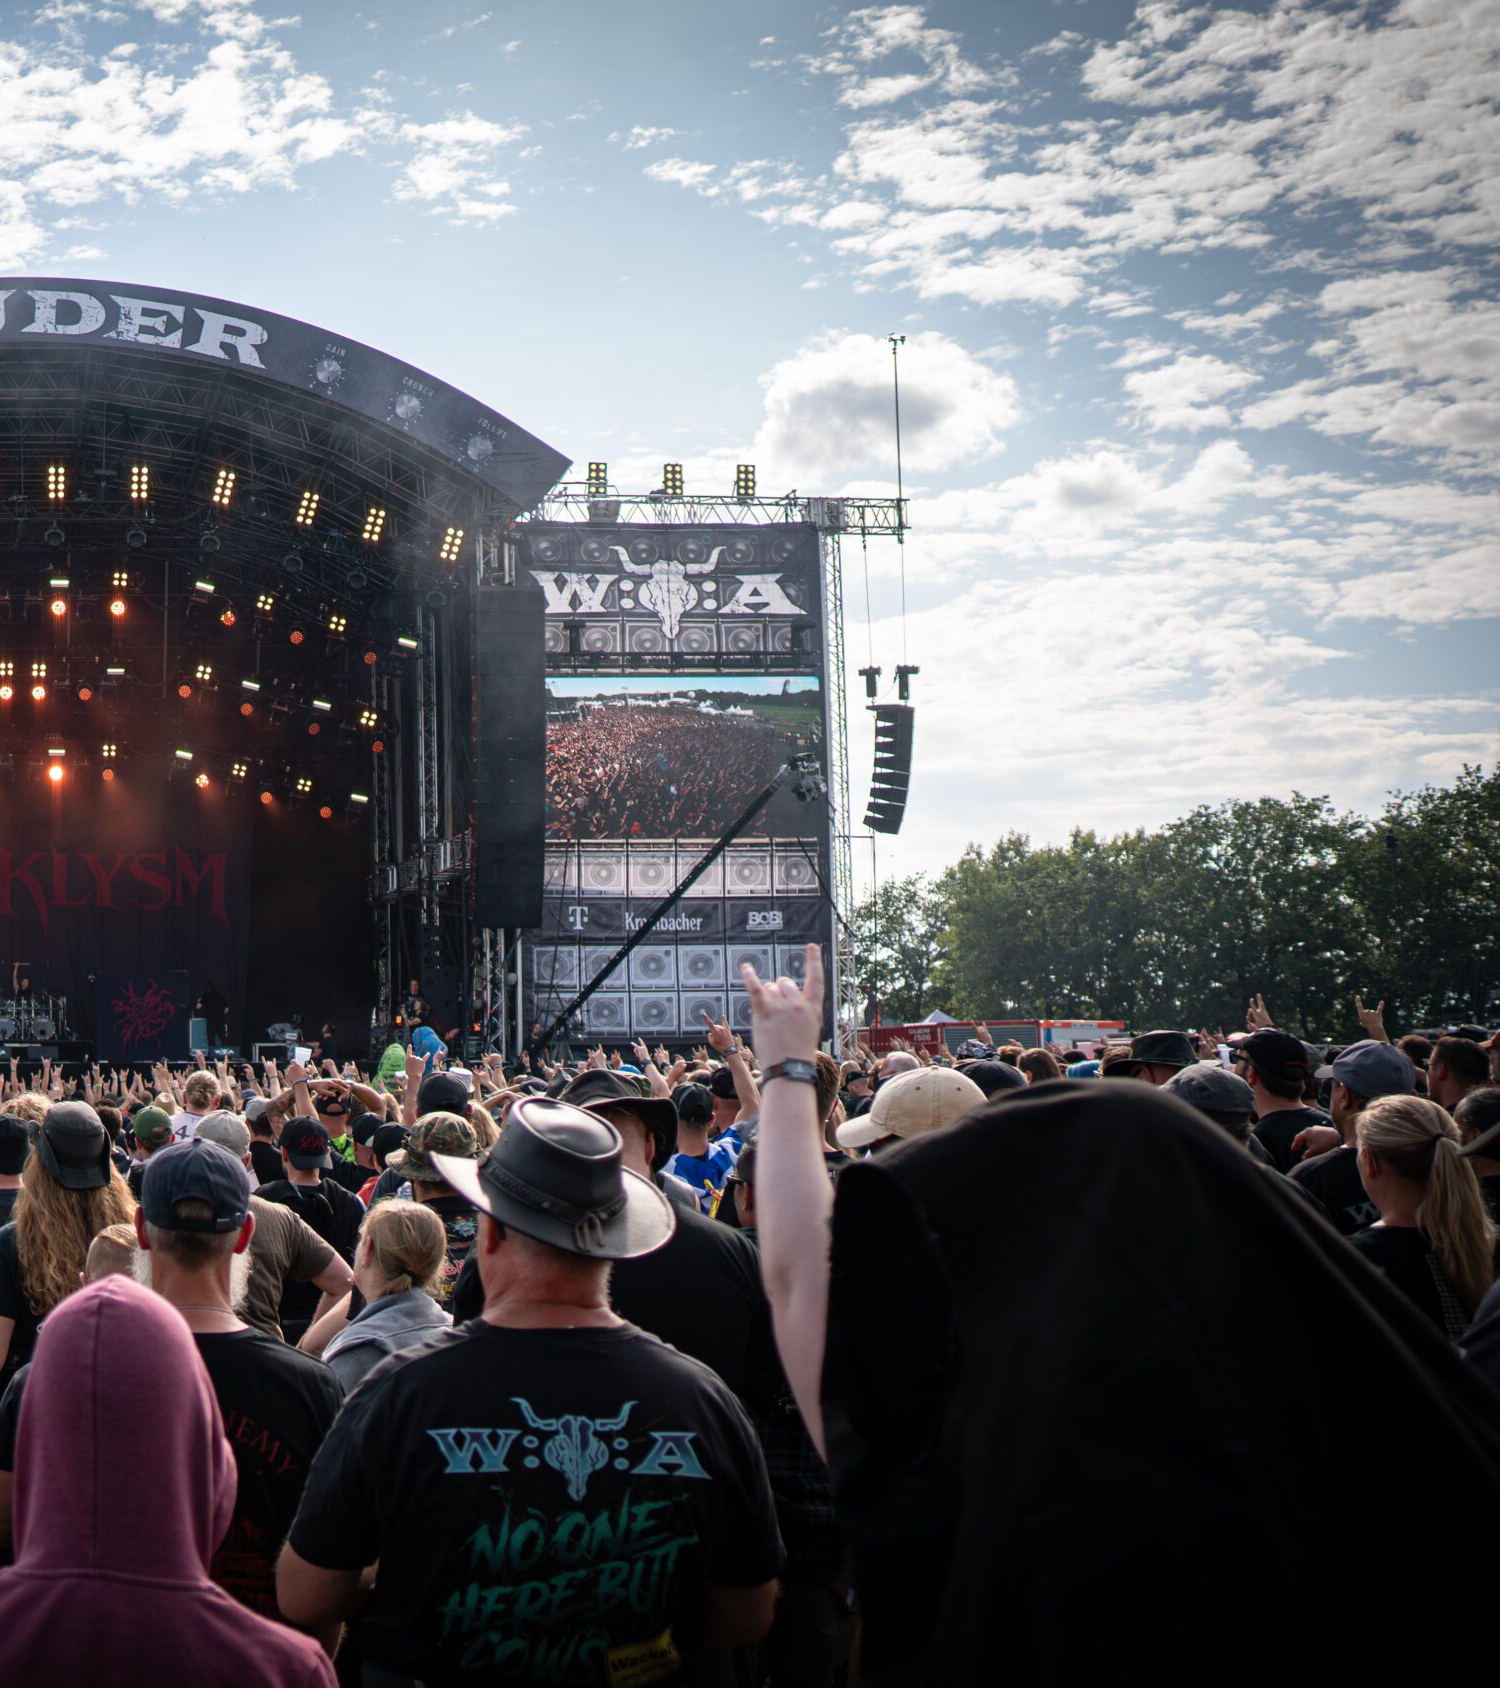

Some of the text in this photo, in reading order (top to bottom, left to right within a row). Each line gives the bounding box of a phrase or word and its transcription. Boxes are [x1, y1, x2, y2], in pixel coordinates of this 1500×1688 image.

[325, 343, 347, 357] GAIN
[402, 375, 435, 397] CRUNCH
[625, 912, 703, 931] Krobacher
[748, 911, 783, 925] BOB!
[469, 1488, 682, 1574] NO ONE
[437, 1536, 700, 1640] HERE BUT
